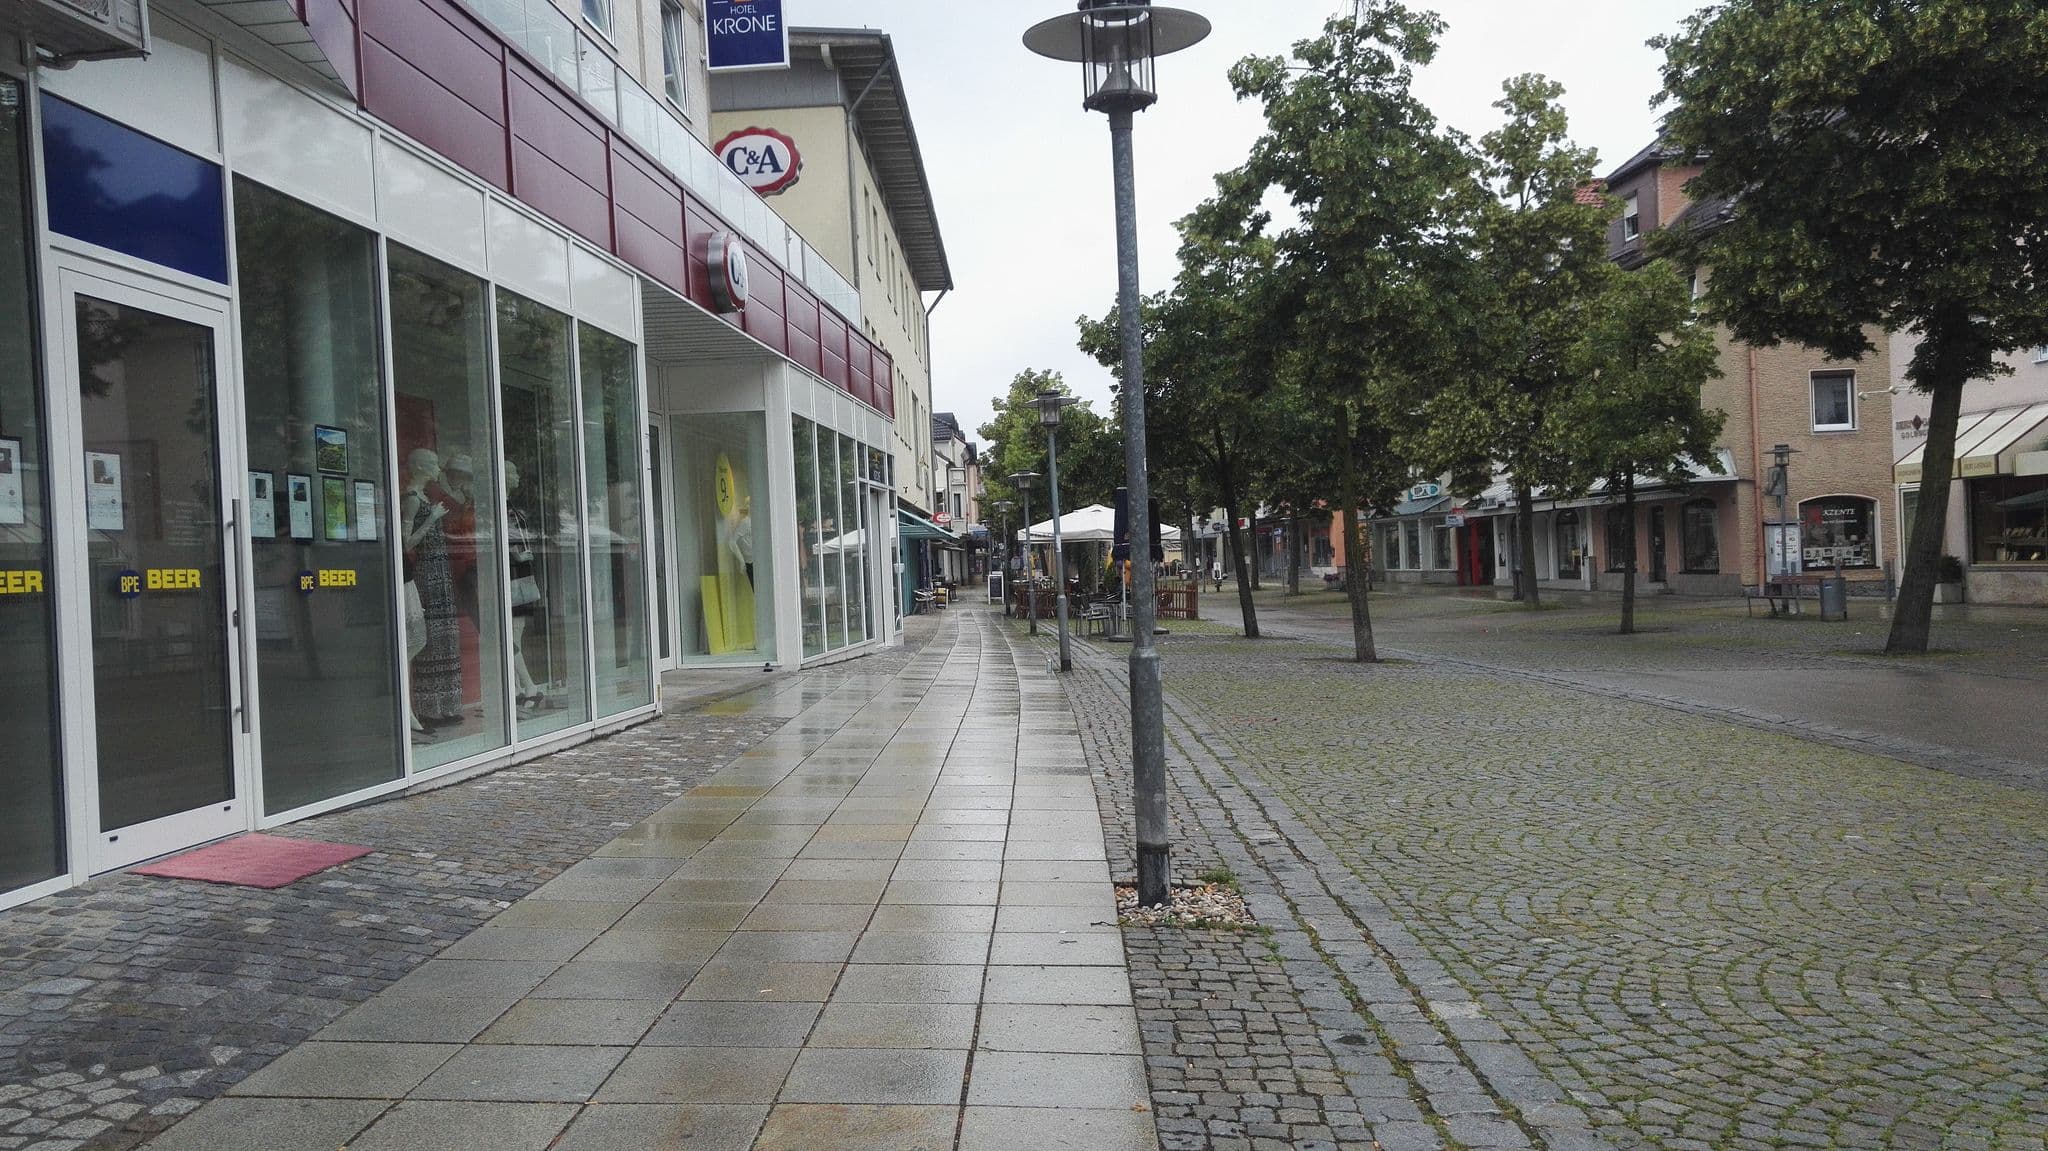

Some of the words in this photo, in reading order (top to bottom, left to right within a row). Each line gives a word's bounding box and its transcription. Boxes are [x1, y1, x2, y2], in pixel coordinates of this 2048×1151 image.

[730, 4, 757, 15] HOTEL
[713, 14, 776, 35] KRONE
[726, 144, 784, 176] C&A
[121, 575, 140, 593] BPE
[146, 568, 201, 589] BEER
[300, 575, 314, 590] BPE
[319, 569, 356, 586] BEER
